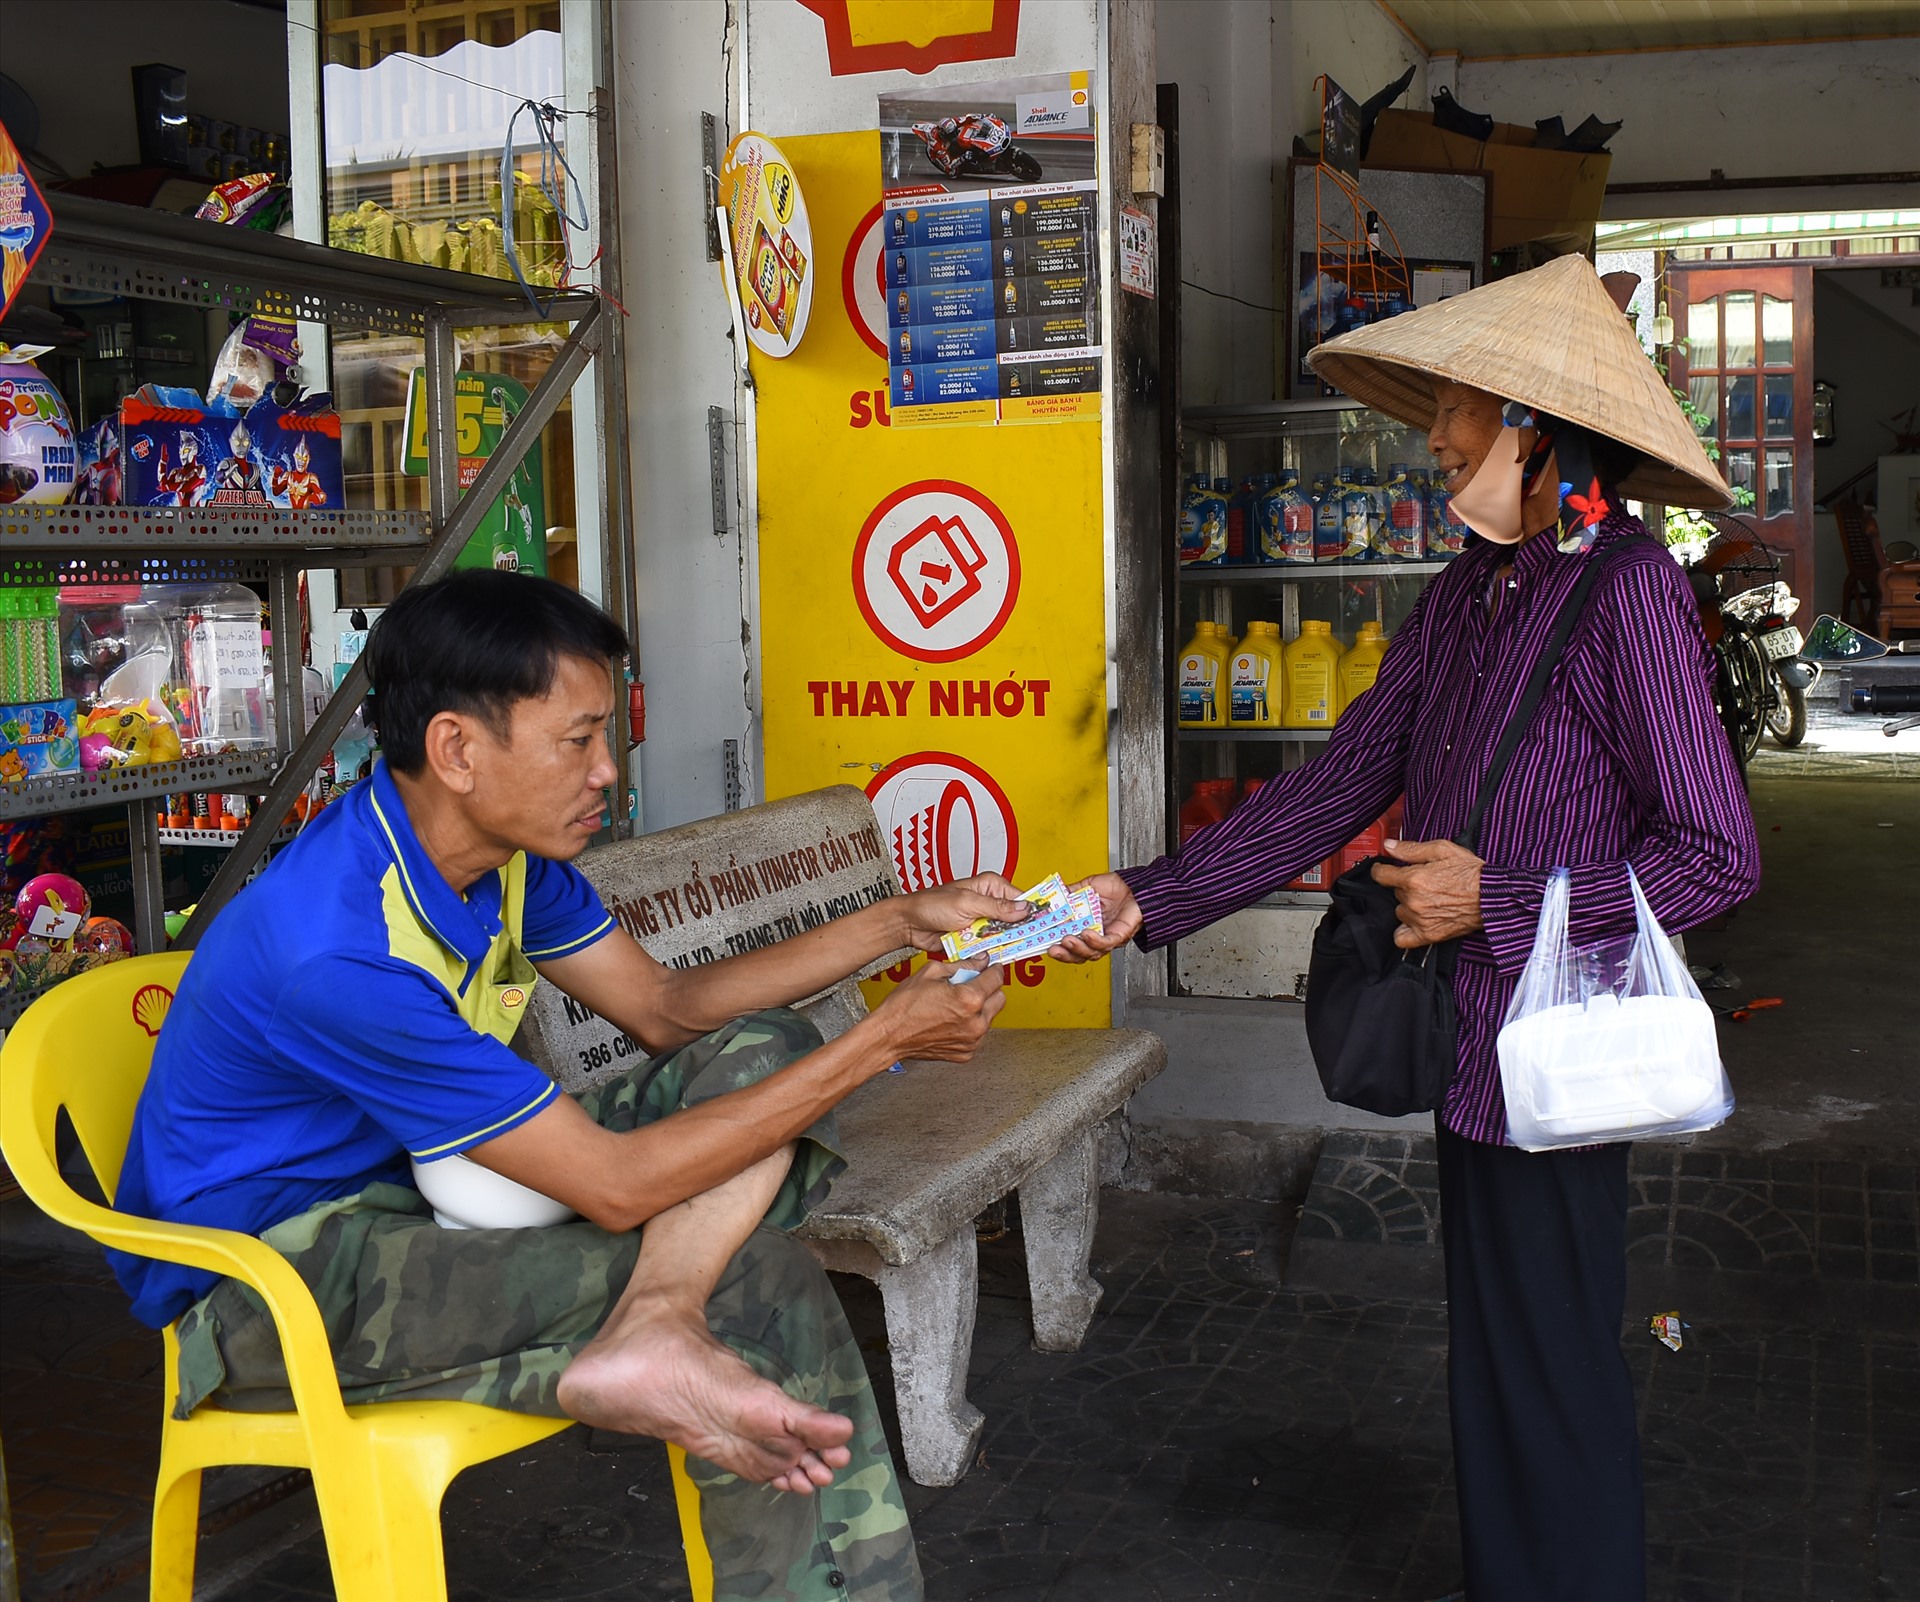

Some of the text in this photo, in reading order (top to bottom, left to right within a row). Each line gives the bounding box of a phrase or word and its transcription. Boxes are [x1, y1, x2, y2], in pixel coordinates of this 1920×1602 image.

[1024, 112, 1068, 123] ADVANCE
[747, 146, 756, 169] NAM
[776, 174, 790, 219] HMO
[759, 250, 770, 288] Grow
[764, 255, 777, 302] PLUS+
[254, 321, 293, 334] Jackfruit Chips
[16, 382, 45, 393] Trứng
[458, 377, 484, 393] năm
[42, 446, 74, 464] IRON
[44, 466, 73, 483] MAN
[215, 490, 264, 503] WATER GUN
[496, 559, 517, 572] MILO
[808, 670, 1050, 718] THAY NHỚT
[27, 735, 47, 744] STICK
[103, 872, 119, 882] BIA
[607, 825, 881, 940] ÔNG TY CỔ PHẦN VINAFOR CẦN THƠ
[726, 924, 777, 956] TRANG
[777, 911, 800, 940] TRÍ
[863, 873, 895, 909] THẤT
[578, 1043, 612, 1073] 386
